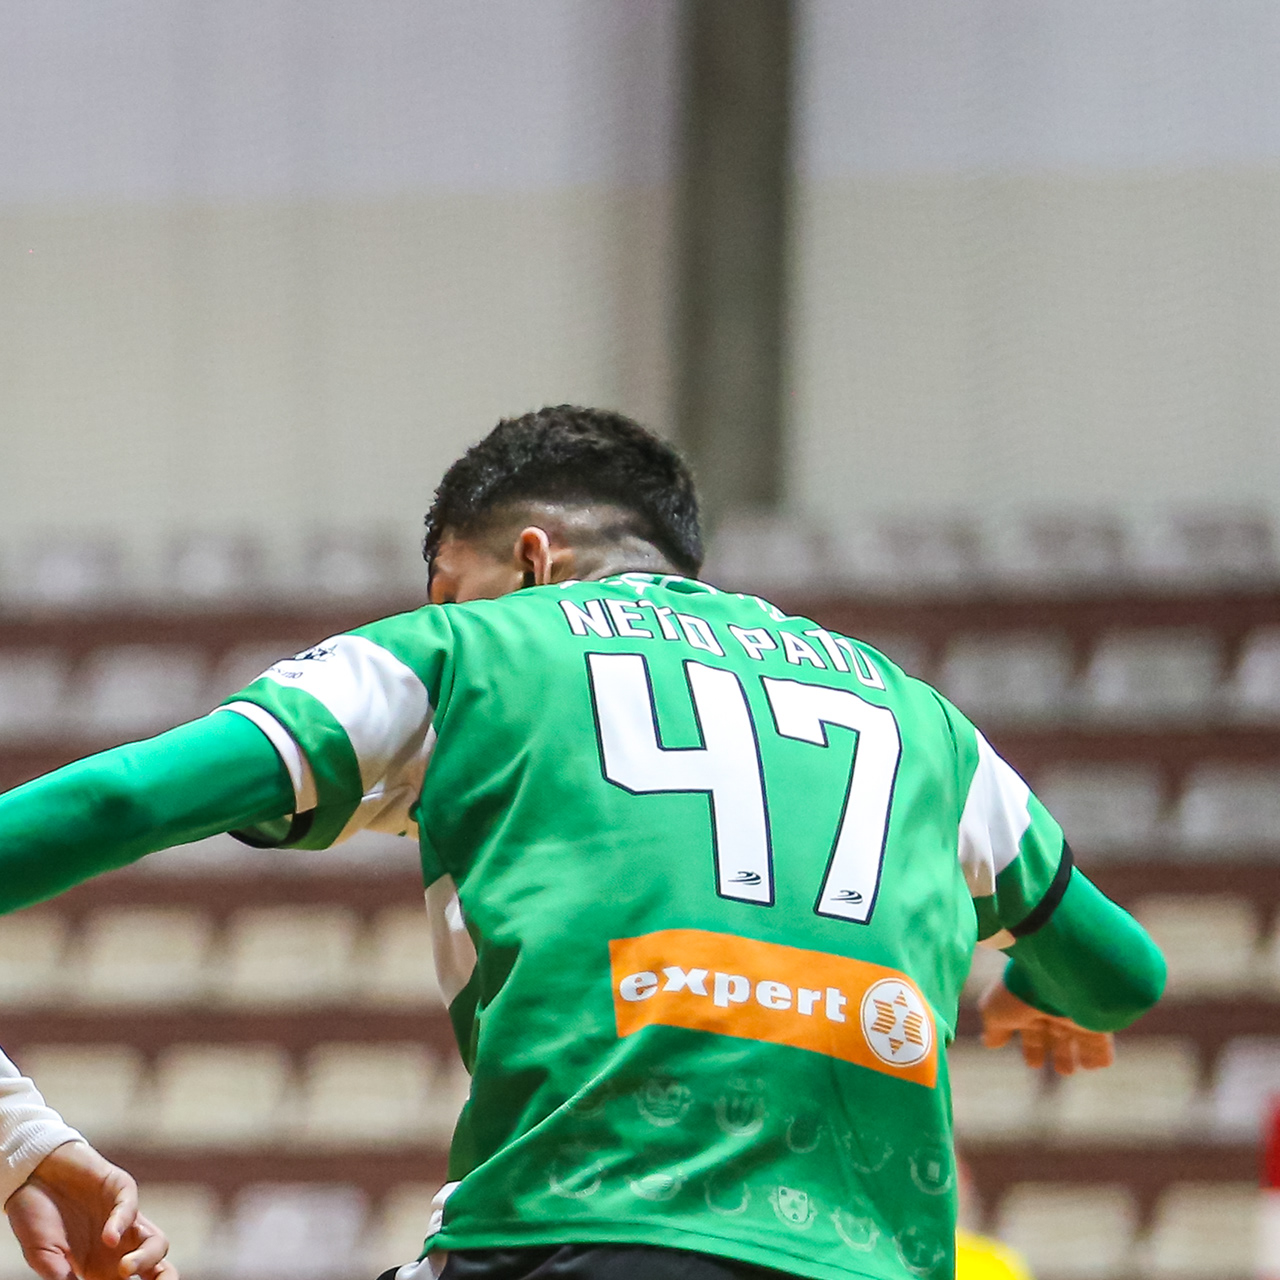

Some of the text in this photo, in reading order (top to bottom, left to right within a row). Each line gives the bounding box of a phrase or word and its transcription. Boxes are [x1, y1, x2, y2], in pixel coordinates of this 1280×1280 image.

[558, 598, 725, 657] NETO
[586, 652, 902, 925] 47
[619, 965, 848, 1024] expert
